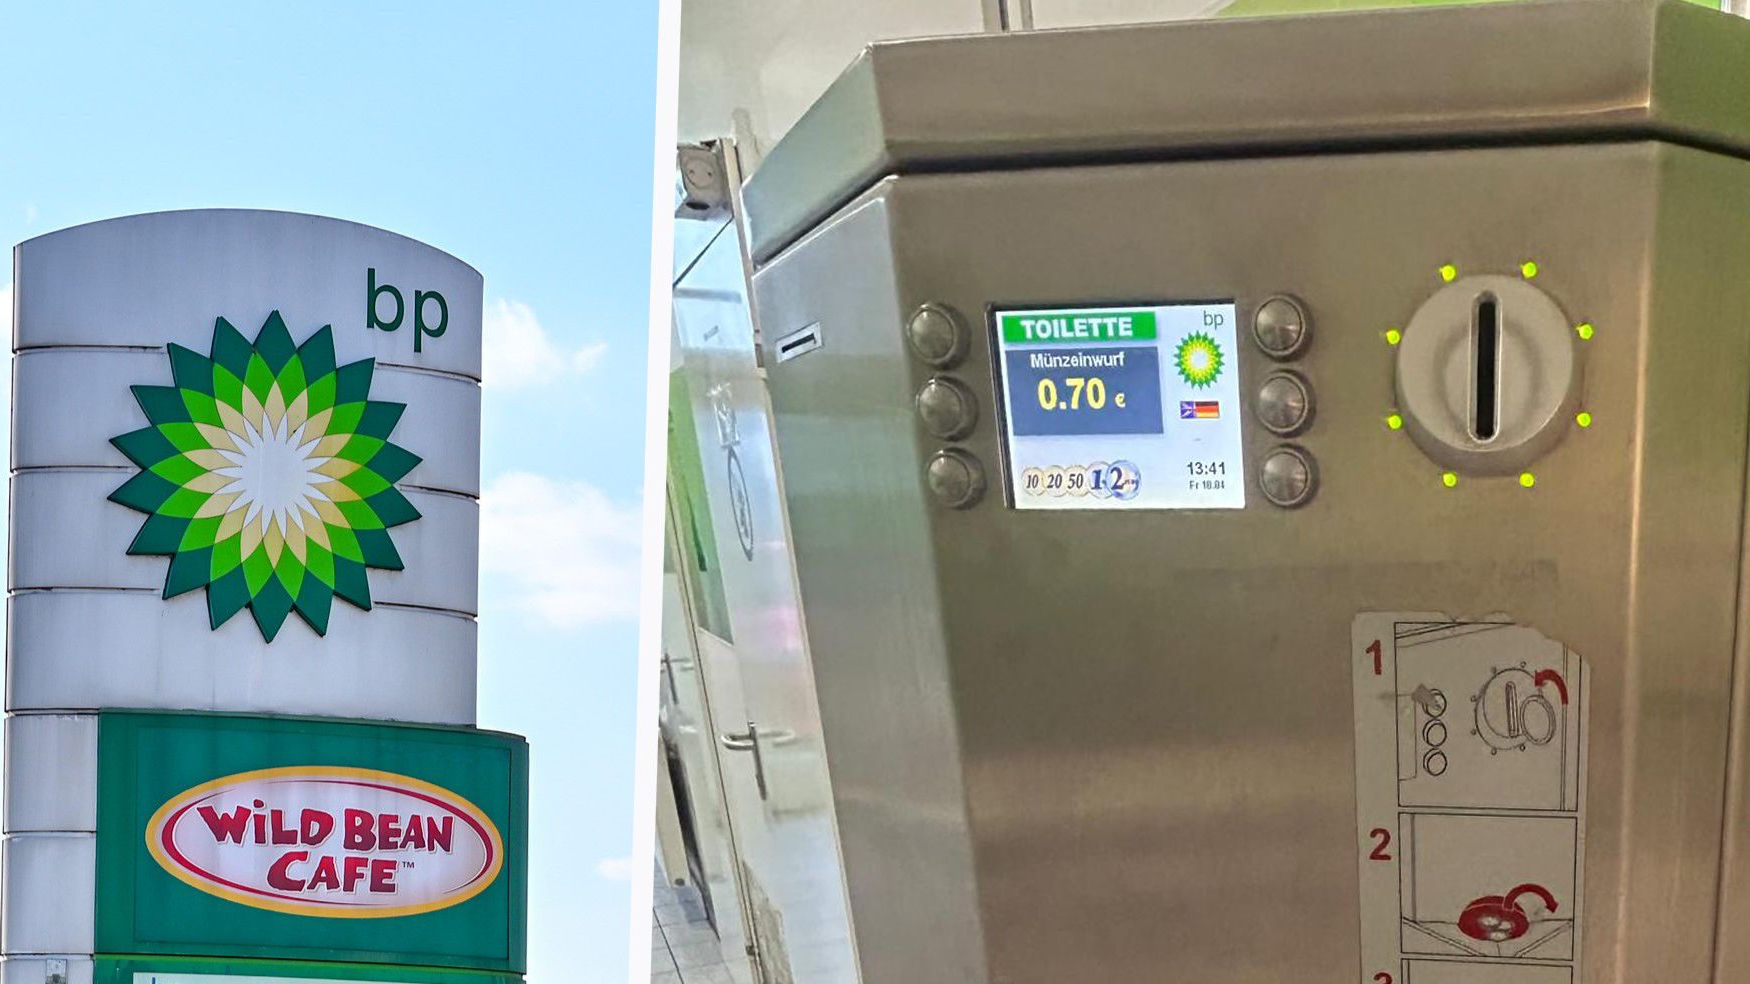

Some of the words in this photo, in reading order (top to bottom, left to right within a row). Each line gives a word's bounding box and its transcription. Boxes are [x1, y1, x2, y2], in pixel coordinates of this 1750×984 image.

[366, 267, 449, 353] bp
[1203, 310, 1224, 330] bp
[1020, 317, 1133, 339] TOILETTE
[1030, 352, 1125, 368] Münzeinwurf
[1037, 378, 1106, 410] 0.70
[1026, 474, 1039, 489] 10
[1047, 473, 1063, 489] 20
[1067, 473, 1084, 489] 50
[1187, 461, 1225, 475] 13:41
[1365, 639, 1382, 675] 1
[343, 808, 454, 853] BEAN
[1369, 827, 1392, 861] 2
[266, 850, 398, 893] CAFE
